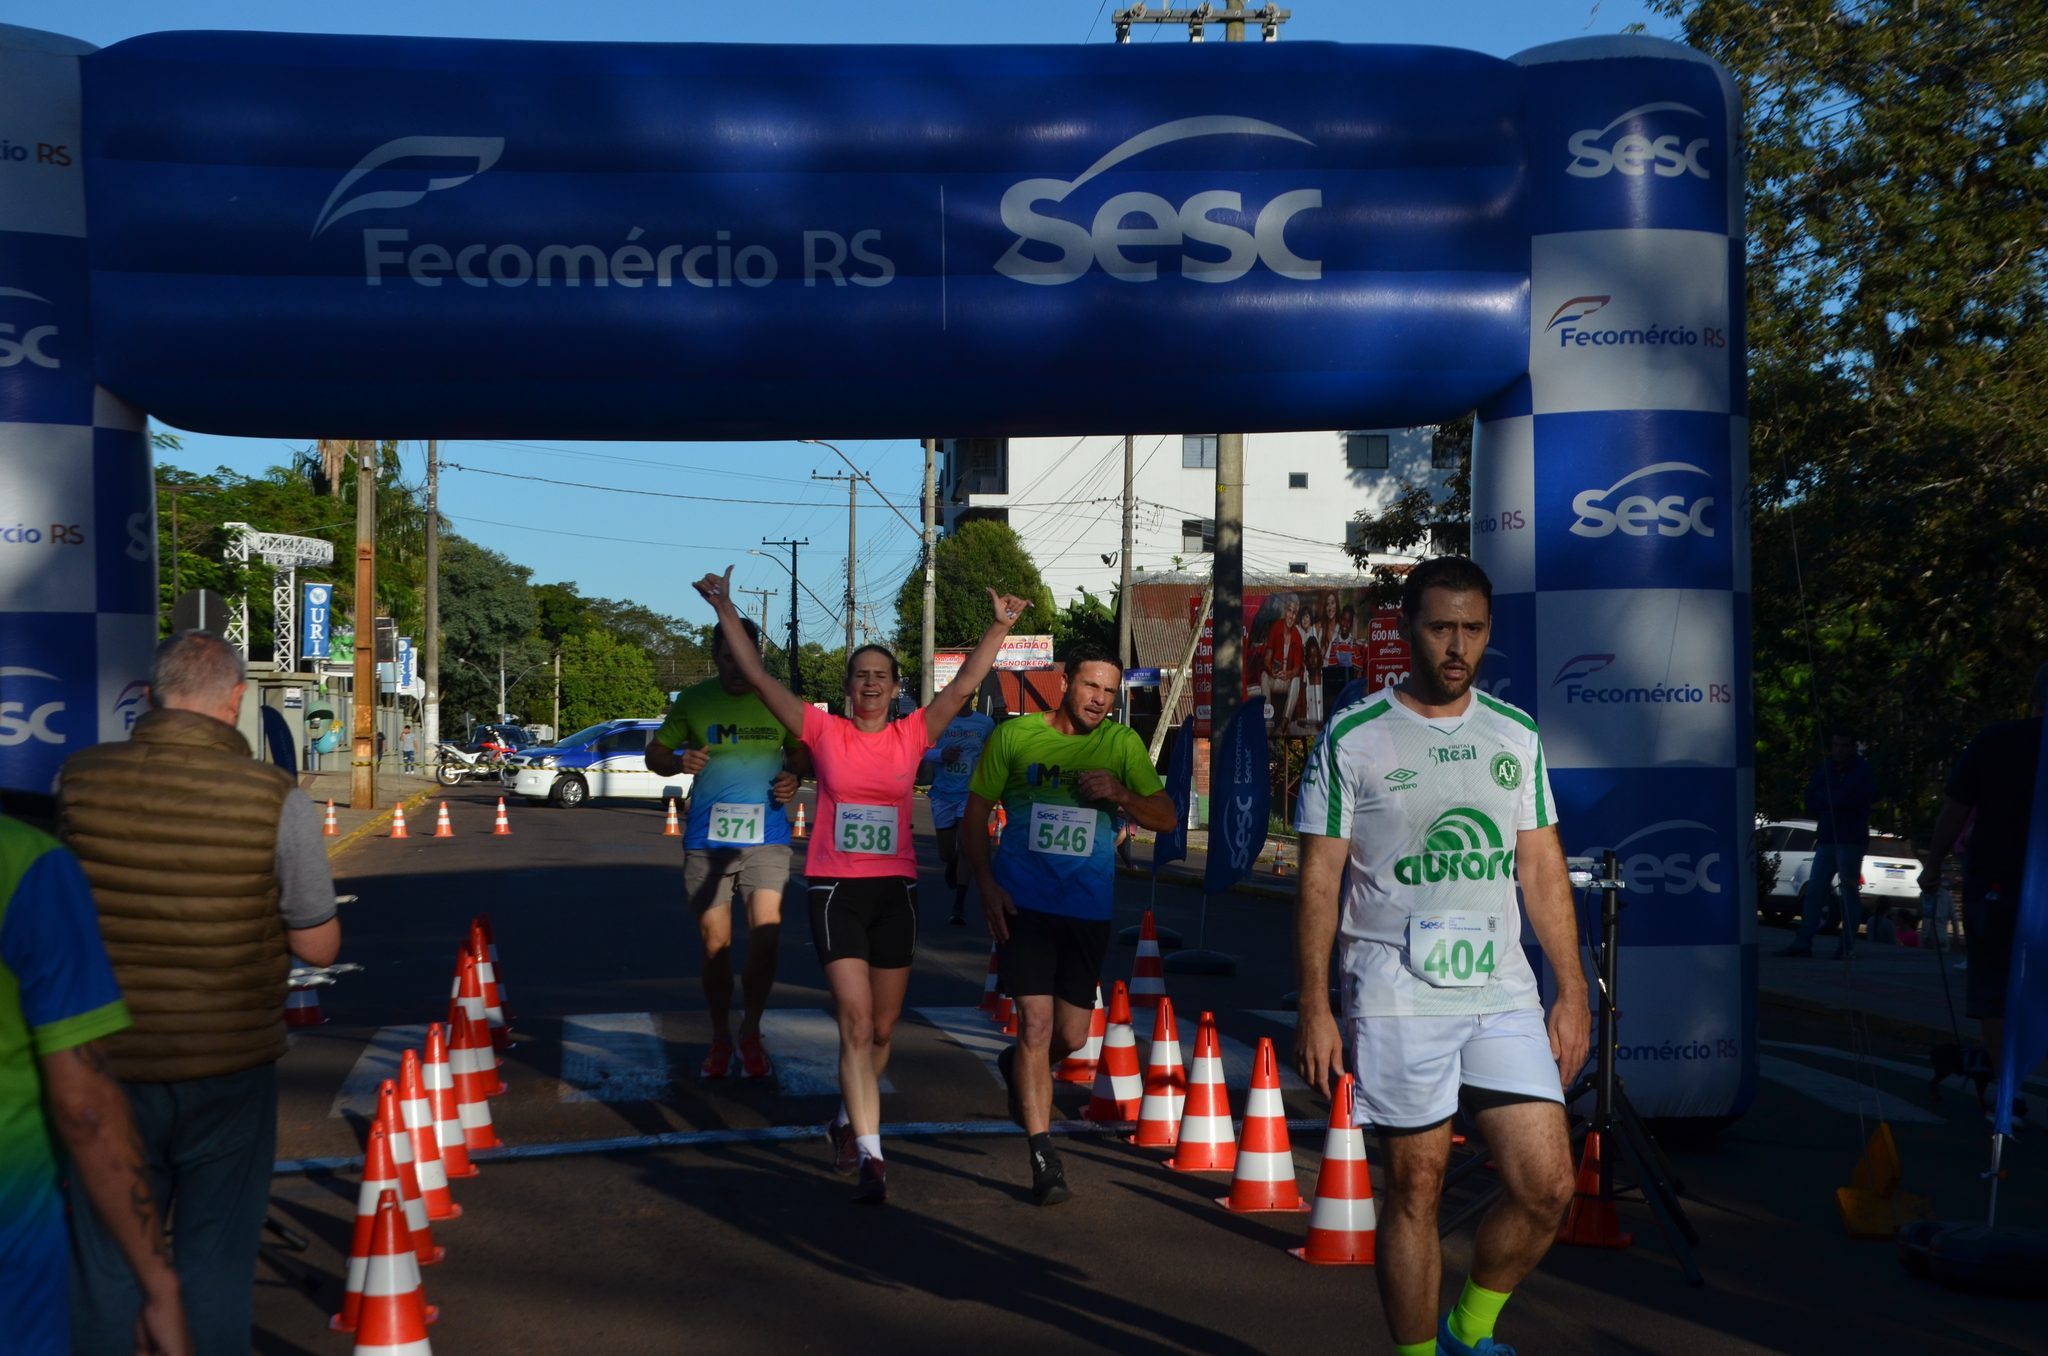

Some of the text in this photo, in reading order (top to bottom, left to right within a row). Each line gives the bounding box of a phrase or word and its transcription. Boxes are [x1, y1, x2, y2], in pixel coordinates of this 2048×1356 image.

[37, 143, 72, 167] RS
[362, 225, 896, 288] Fecomércio RS
[1560, 324, 1726, 348] Fecomércio RS
[1501, 510, 1525, 531] RS
[51, 524, 85, 545] RS
[309, 607, 326, 656] URI
[1567, 682, 1732, 704] Fecomércio RS
[1438, 744, 1478, 763] Real
[1389, 782, 1418, 792] umbro
[716, 817, 756, 839] 371
[843, 823, 891, 851] 538
[1037, 823, 1087, 853] 546
[1424, 938, 1495, 980] 404
[1716, 1038, 1738, 1058] RS
